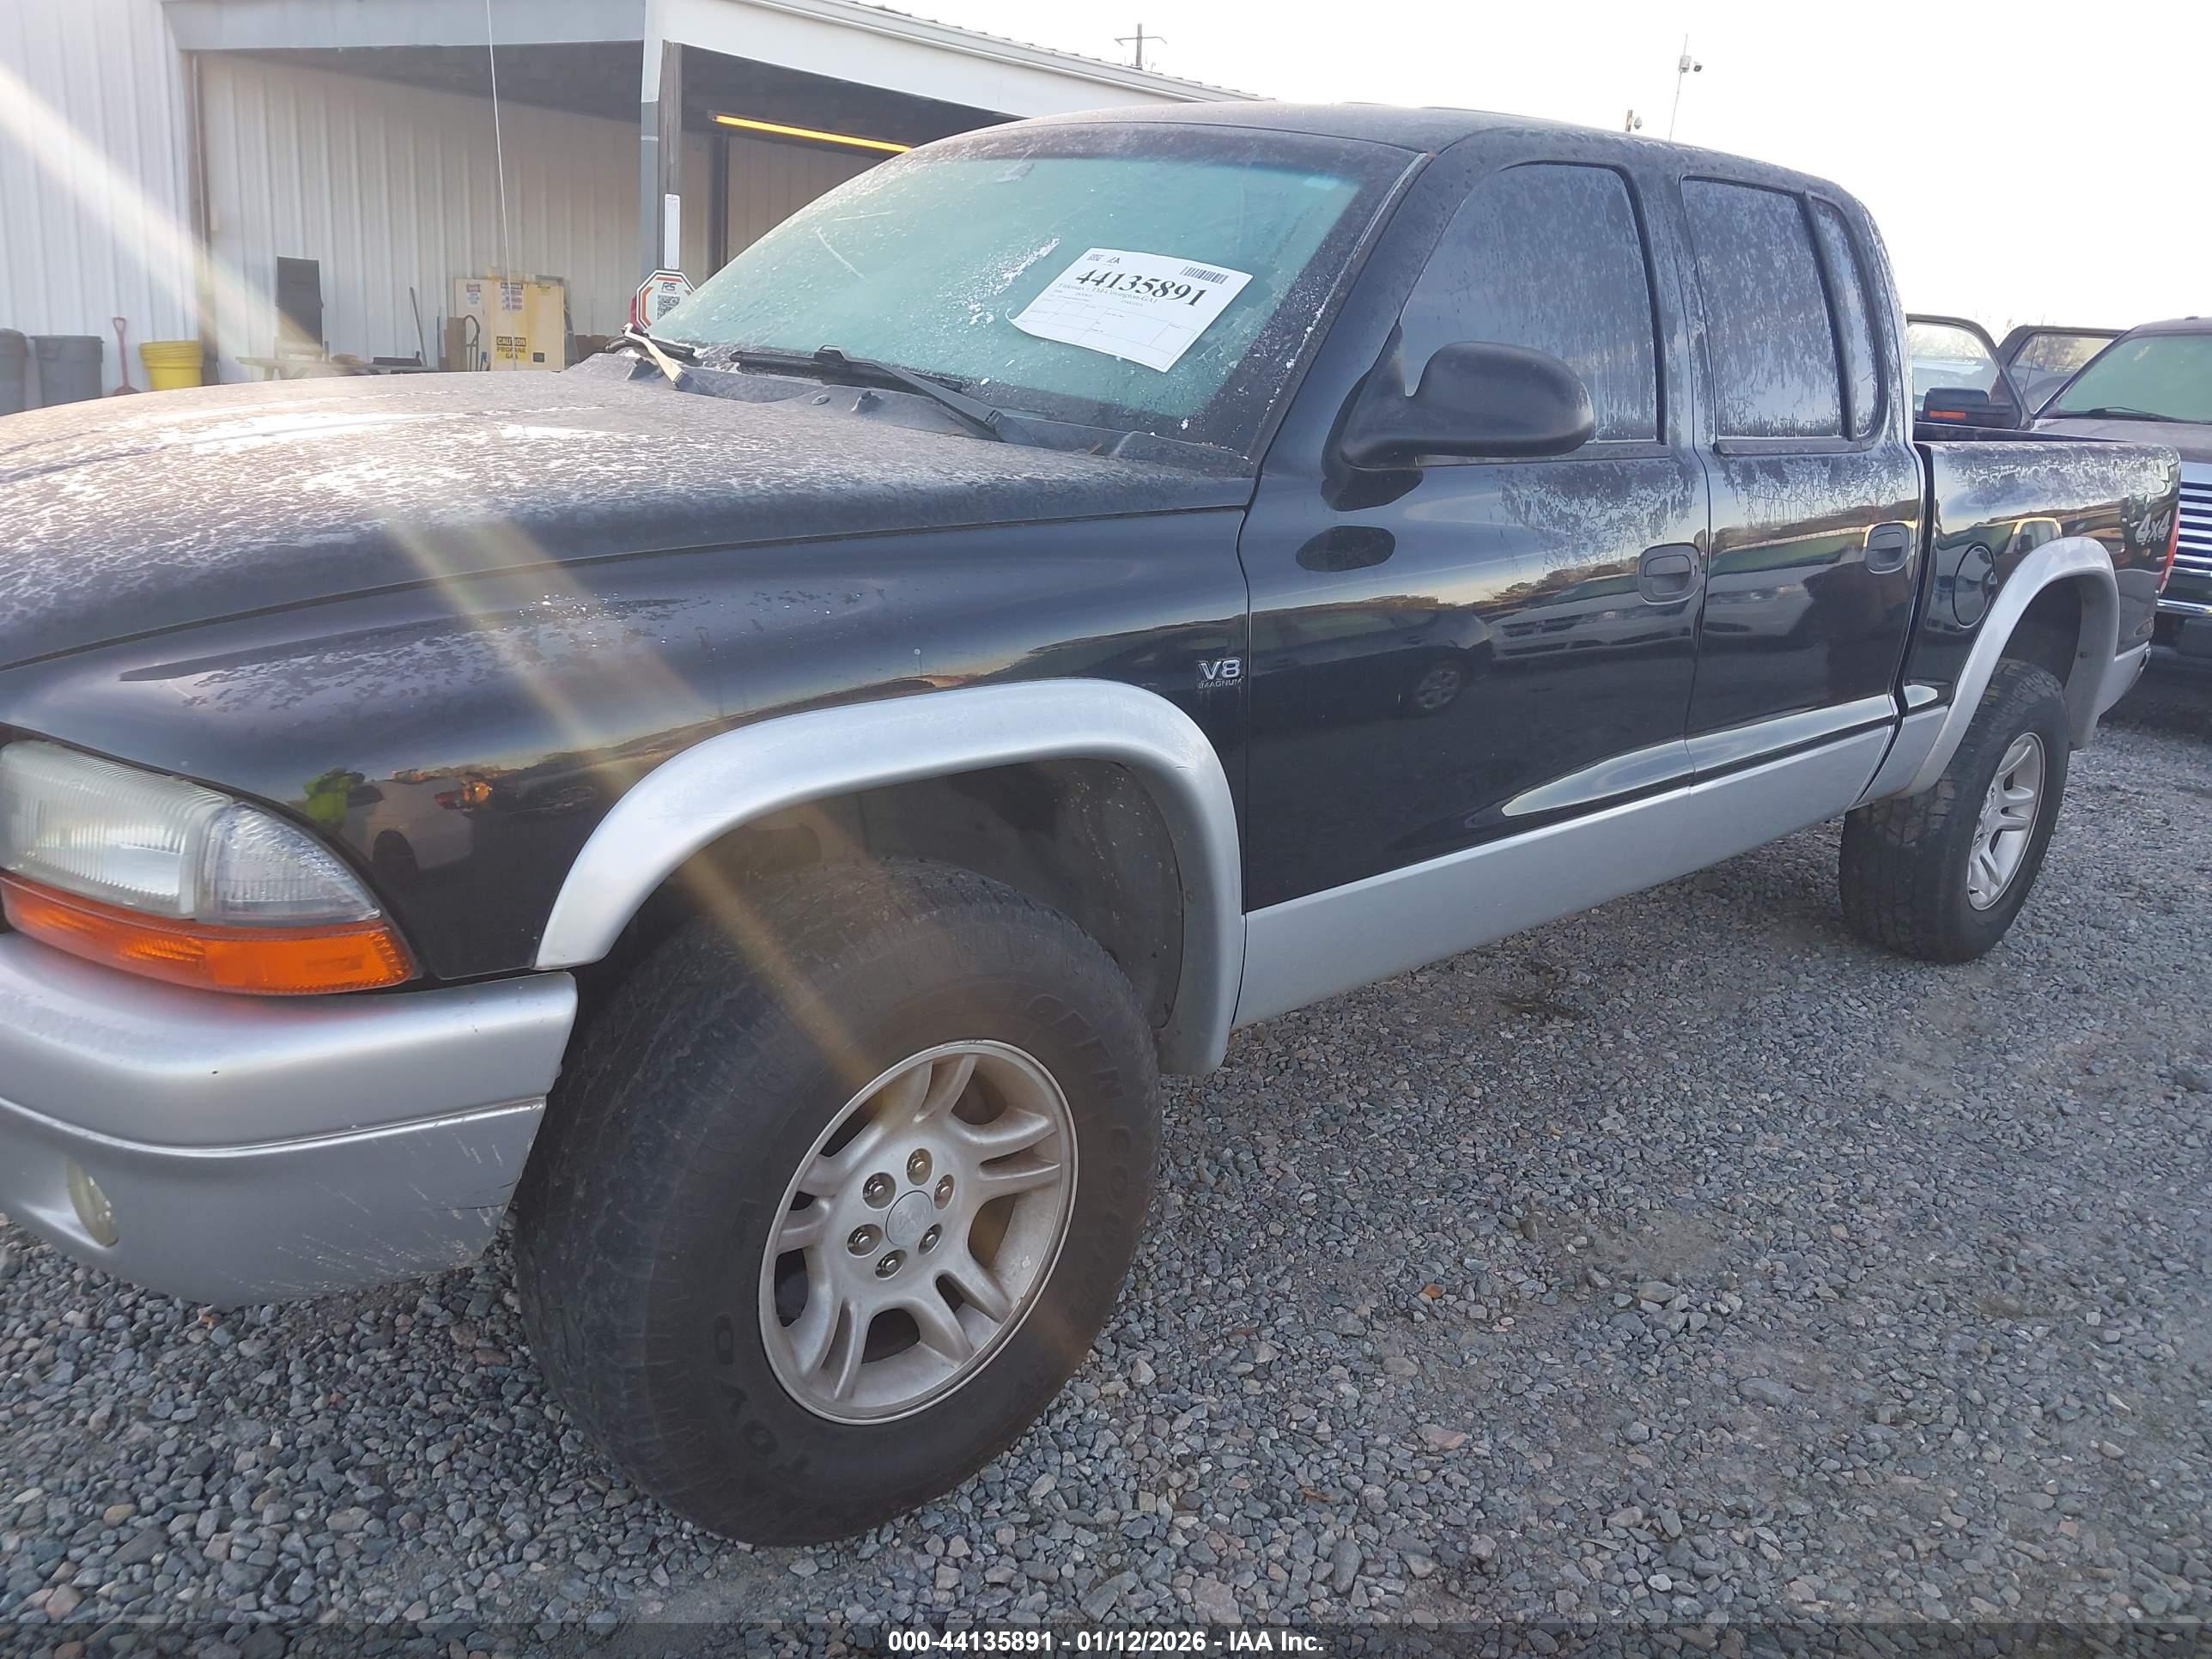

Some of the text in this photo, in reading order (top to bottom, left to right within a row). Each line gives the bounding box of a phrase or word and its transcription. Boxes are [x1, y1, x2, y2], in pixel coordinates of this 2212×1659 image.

[1076, 269, 1207, 307] 44135891
[497, 337, 526, 345] CAUION
[1199, 658, 1242, 681] V8
[1200, 678, 1243, 690] MAGNUM
